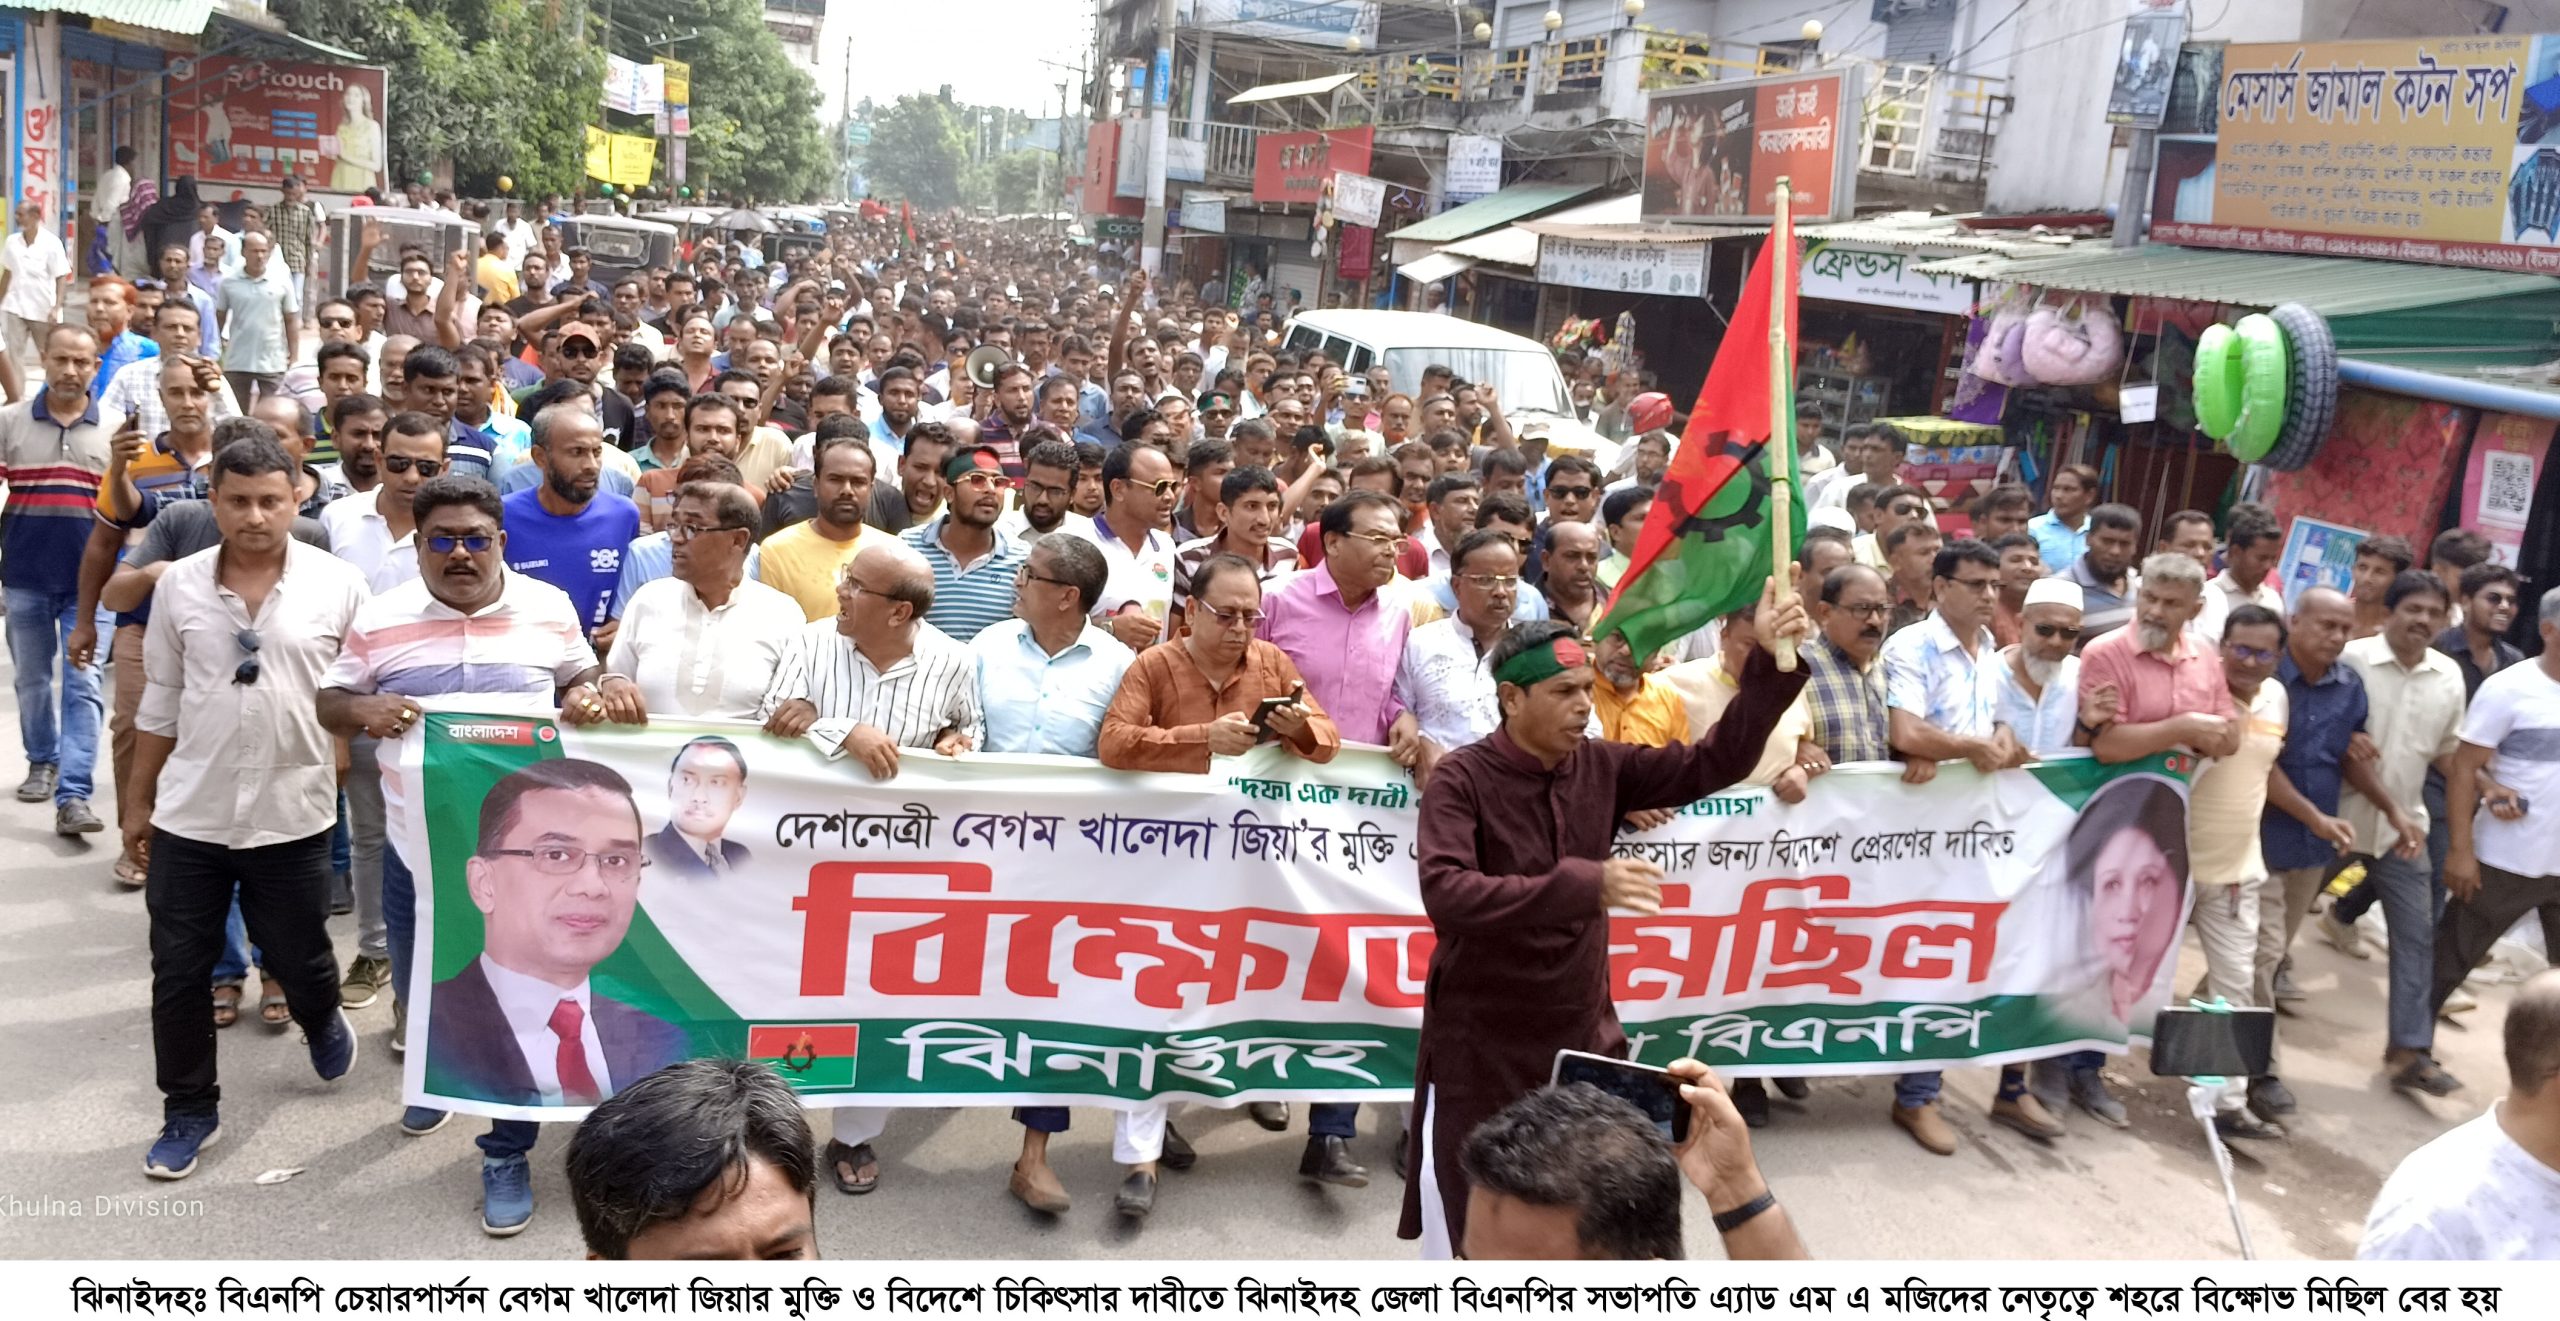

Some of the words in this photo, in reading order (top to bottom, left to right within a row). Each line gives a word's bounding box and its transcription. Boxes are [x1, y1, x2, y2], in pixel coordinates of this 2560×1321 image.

[2224, 48, 2304, 122] মেসার্স
[2306, 62, 2387, 122] জামাল
[2393, 49, 2459, 123] কটন
[2464, 56, 2519, 122] সপ
[1813, 248, 1908, 283] ফ্রেন্ডস
[448, 723, 519, 740] বাংলাদেশ
[1298, 787, 1339, 804] এক
[776, 803, 939, 850] দেশনেত্রী
[953, 810, 1065, 851] বেগম
[1079, 812, 1218, 860] খালেদা
[1338, 821, 1398, 875] মুক্তি
[1708, 841, 1764, 871] জন্য
[1767, 830, 1843, 869] বিদেশে
[1851, 828, 1936, 863] প্রেরণের
[1945, 820, 2016, 858] দাবিতে
[887, 1022, 1388, 1092] ঝিনাইদহ
[1677, 1004, 1992, 1060] বিএনপি
